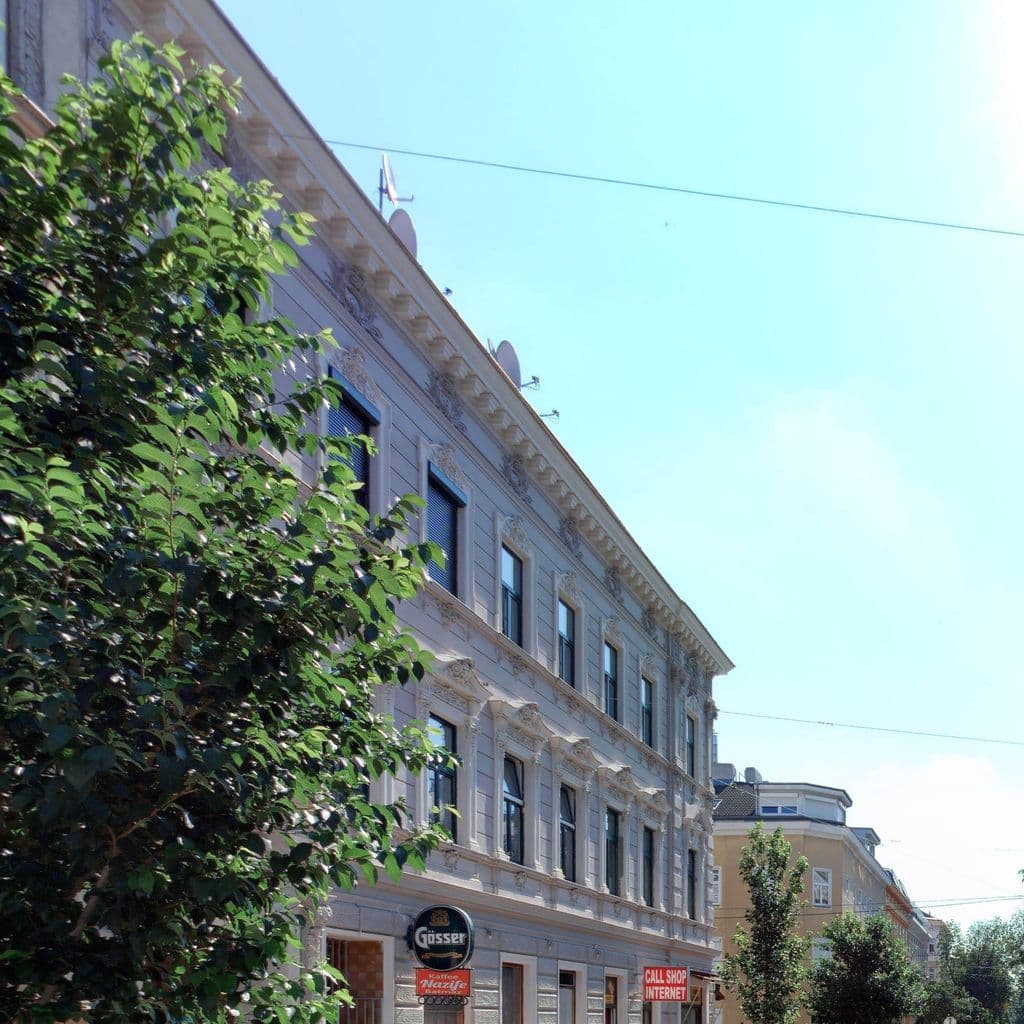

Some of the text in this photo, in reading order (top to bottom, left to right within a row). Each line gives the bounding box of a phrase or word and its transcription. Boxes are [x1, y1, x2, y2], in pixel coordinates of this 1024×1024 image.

[415, 926, 466, 950] Gösser
[645, 969, 687, 985] CALL SHOP
[420, 979, 467, 991] Nazife
[645, 986, 686, 1000] INTERNET
